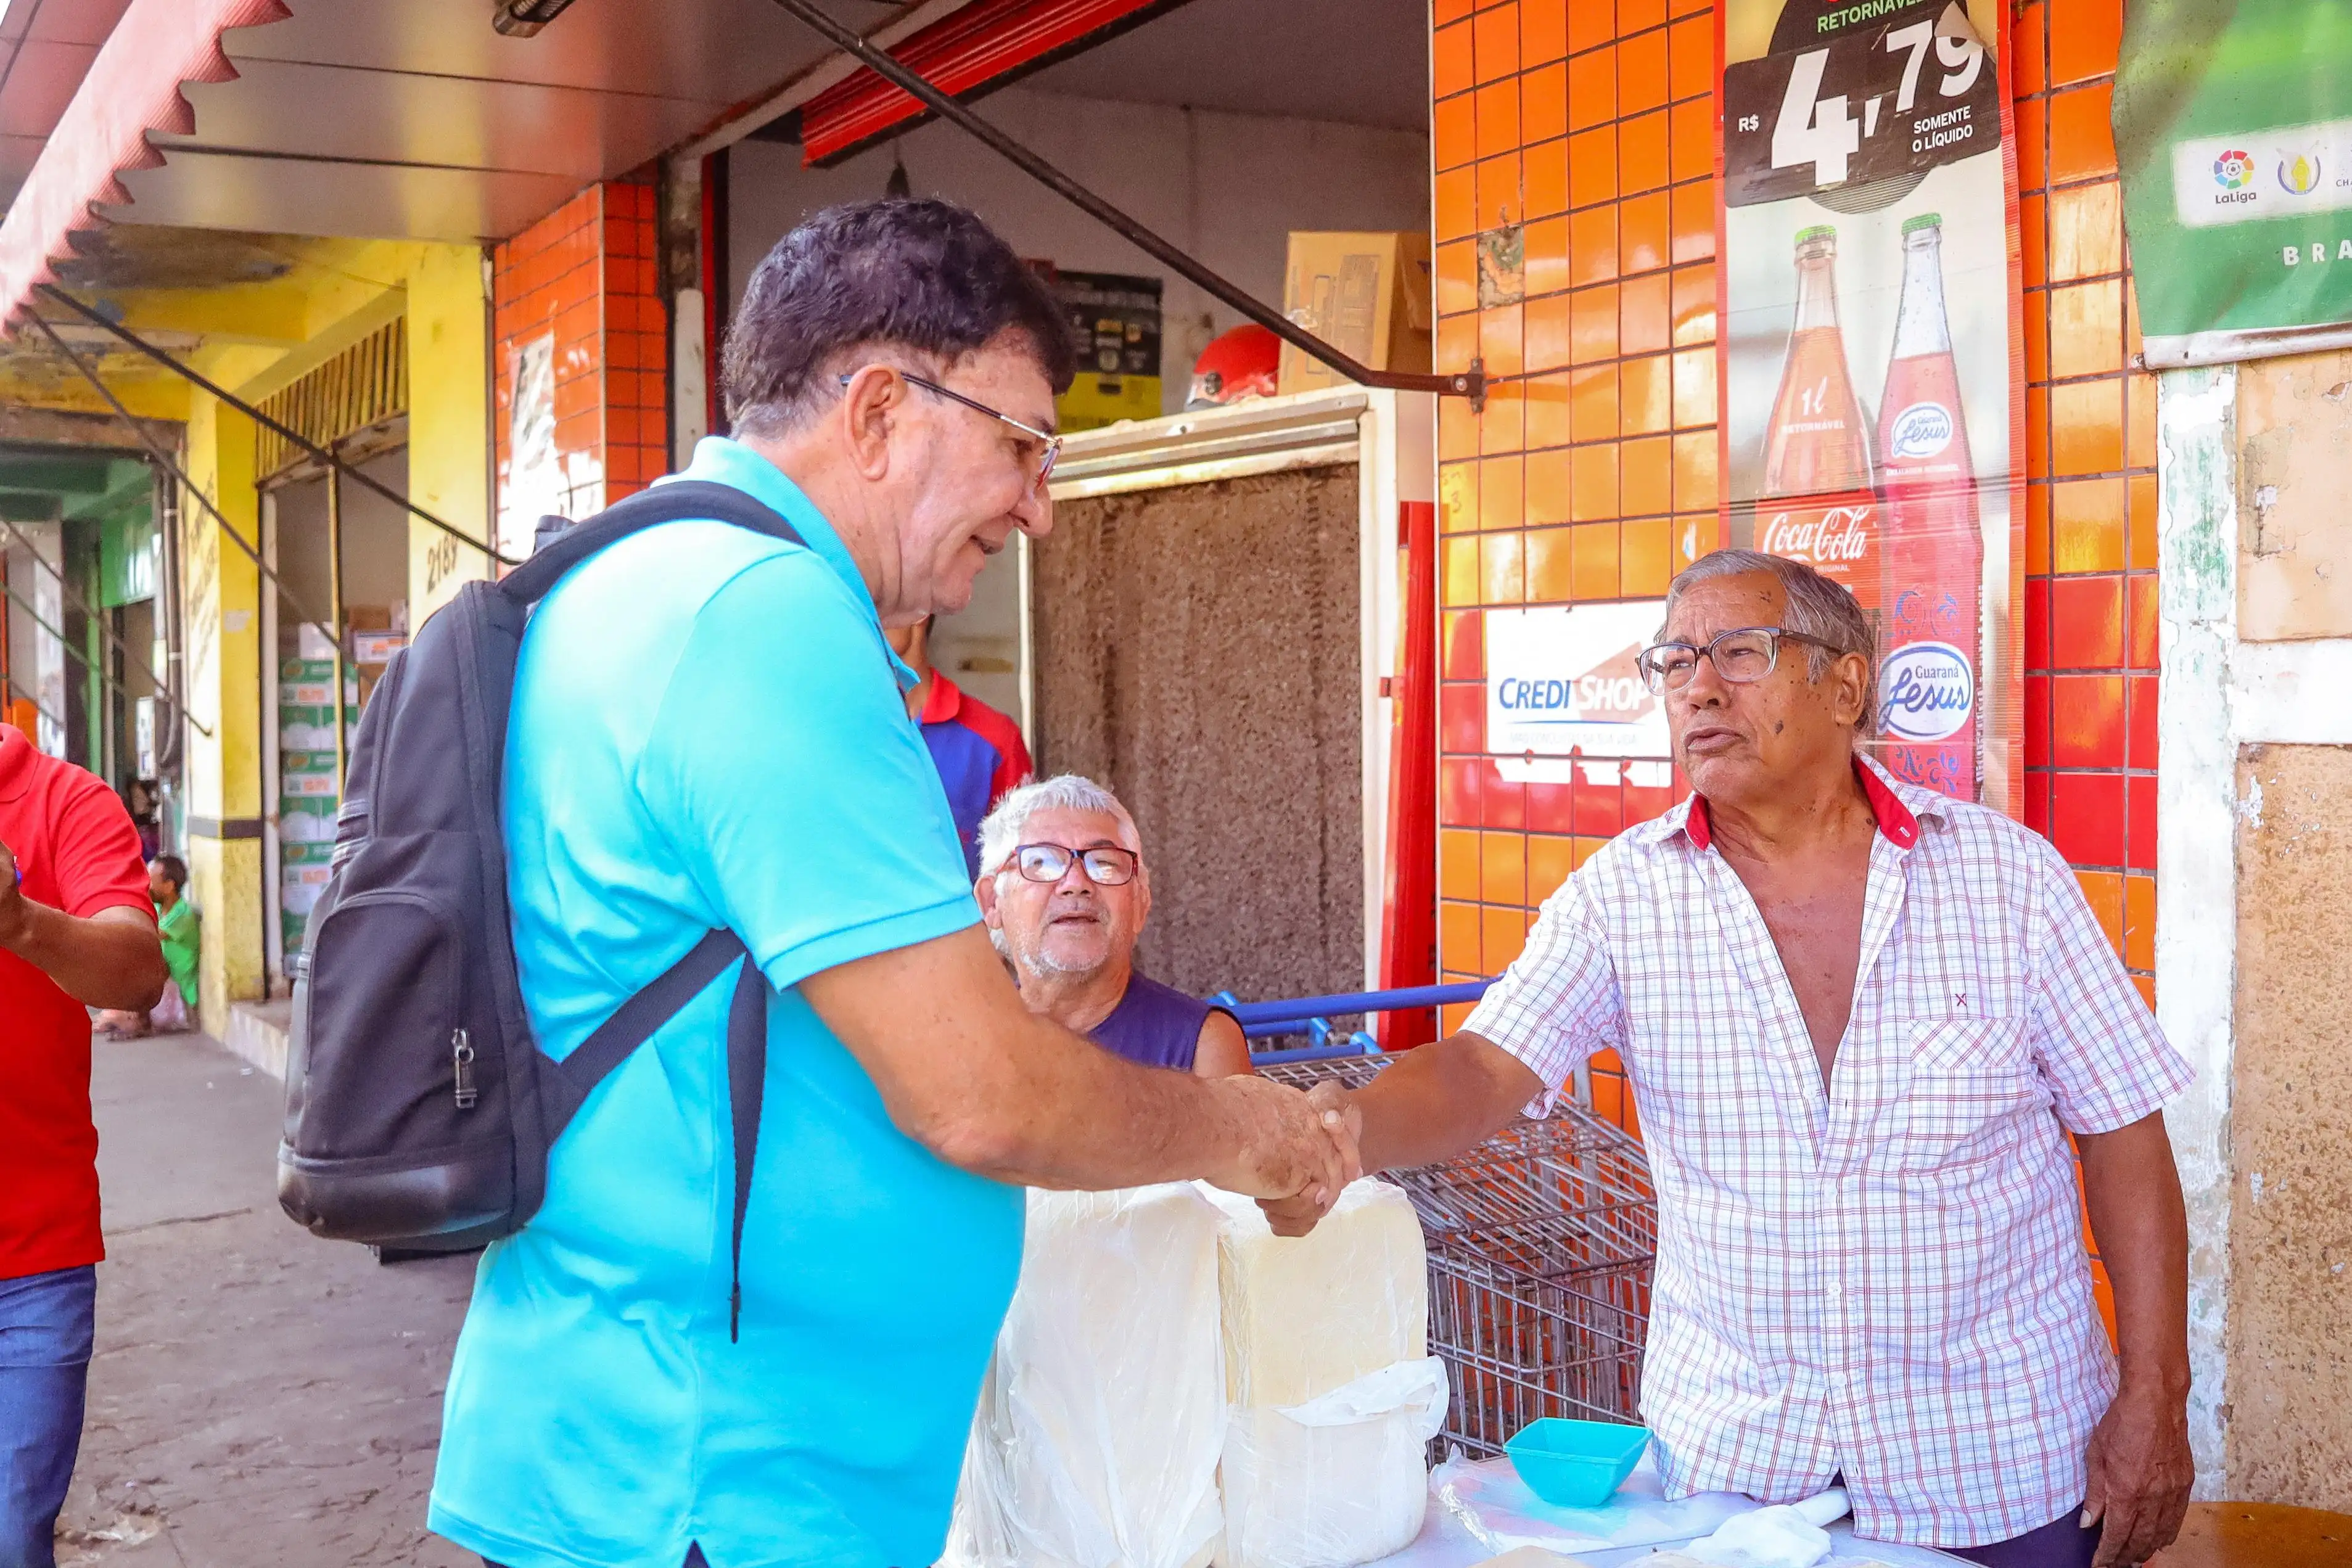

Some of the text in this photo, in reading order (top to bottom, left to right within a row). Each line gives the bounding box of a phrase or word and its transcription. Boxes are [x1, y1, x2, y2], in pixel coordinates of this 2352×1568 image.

[1738, 113, 1759, 132] R$
[1914, 105, 1972, 134] SOMENTE
[1912, 125, 1973, 153] O LÍQUIDO
[2336, 178, 2352, 187] CH
[2215, 191, 2257, 204] LaLiga
[1762, 506, 1869, 562] Coca-Cola
[1915, 663, 1959, 678] Guaraná
[1877, 667, 1969, 731] Jesus
